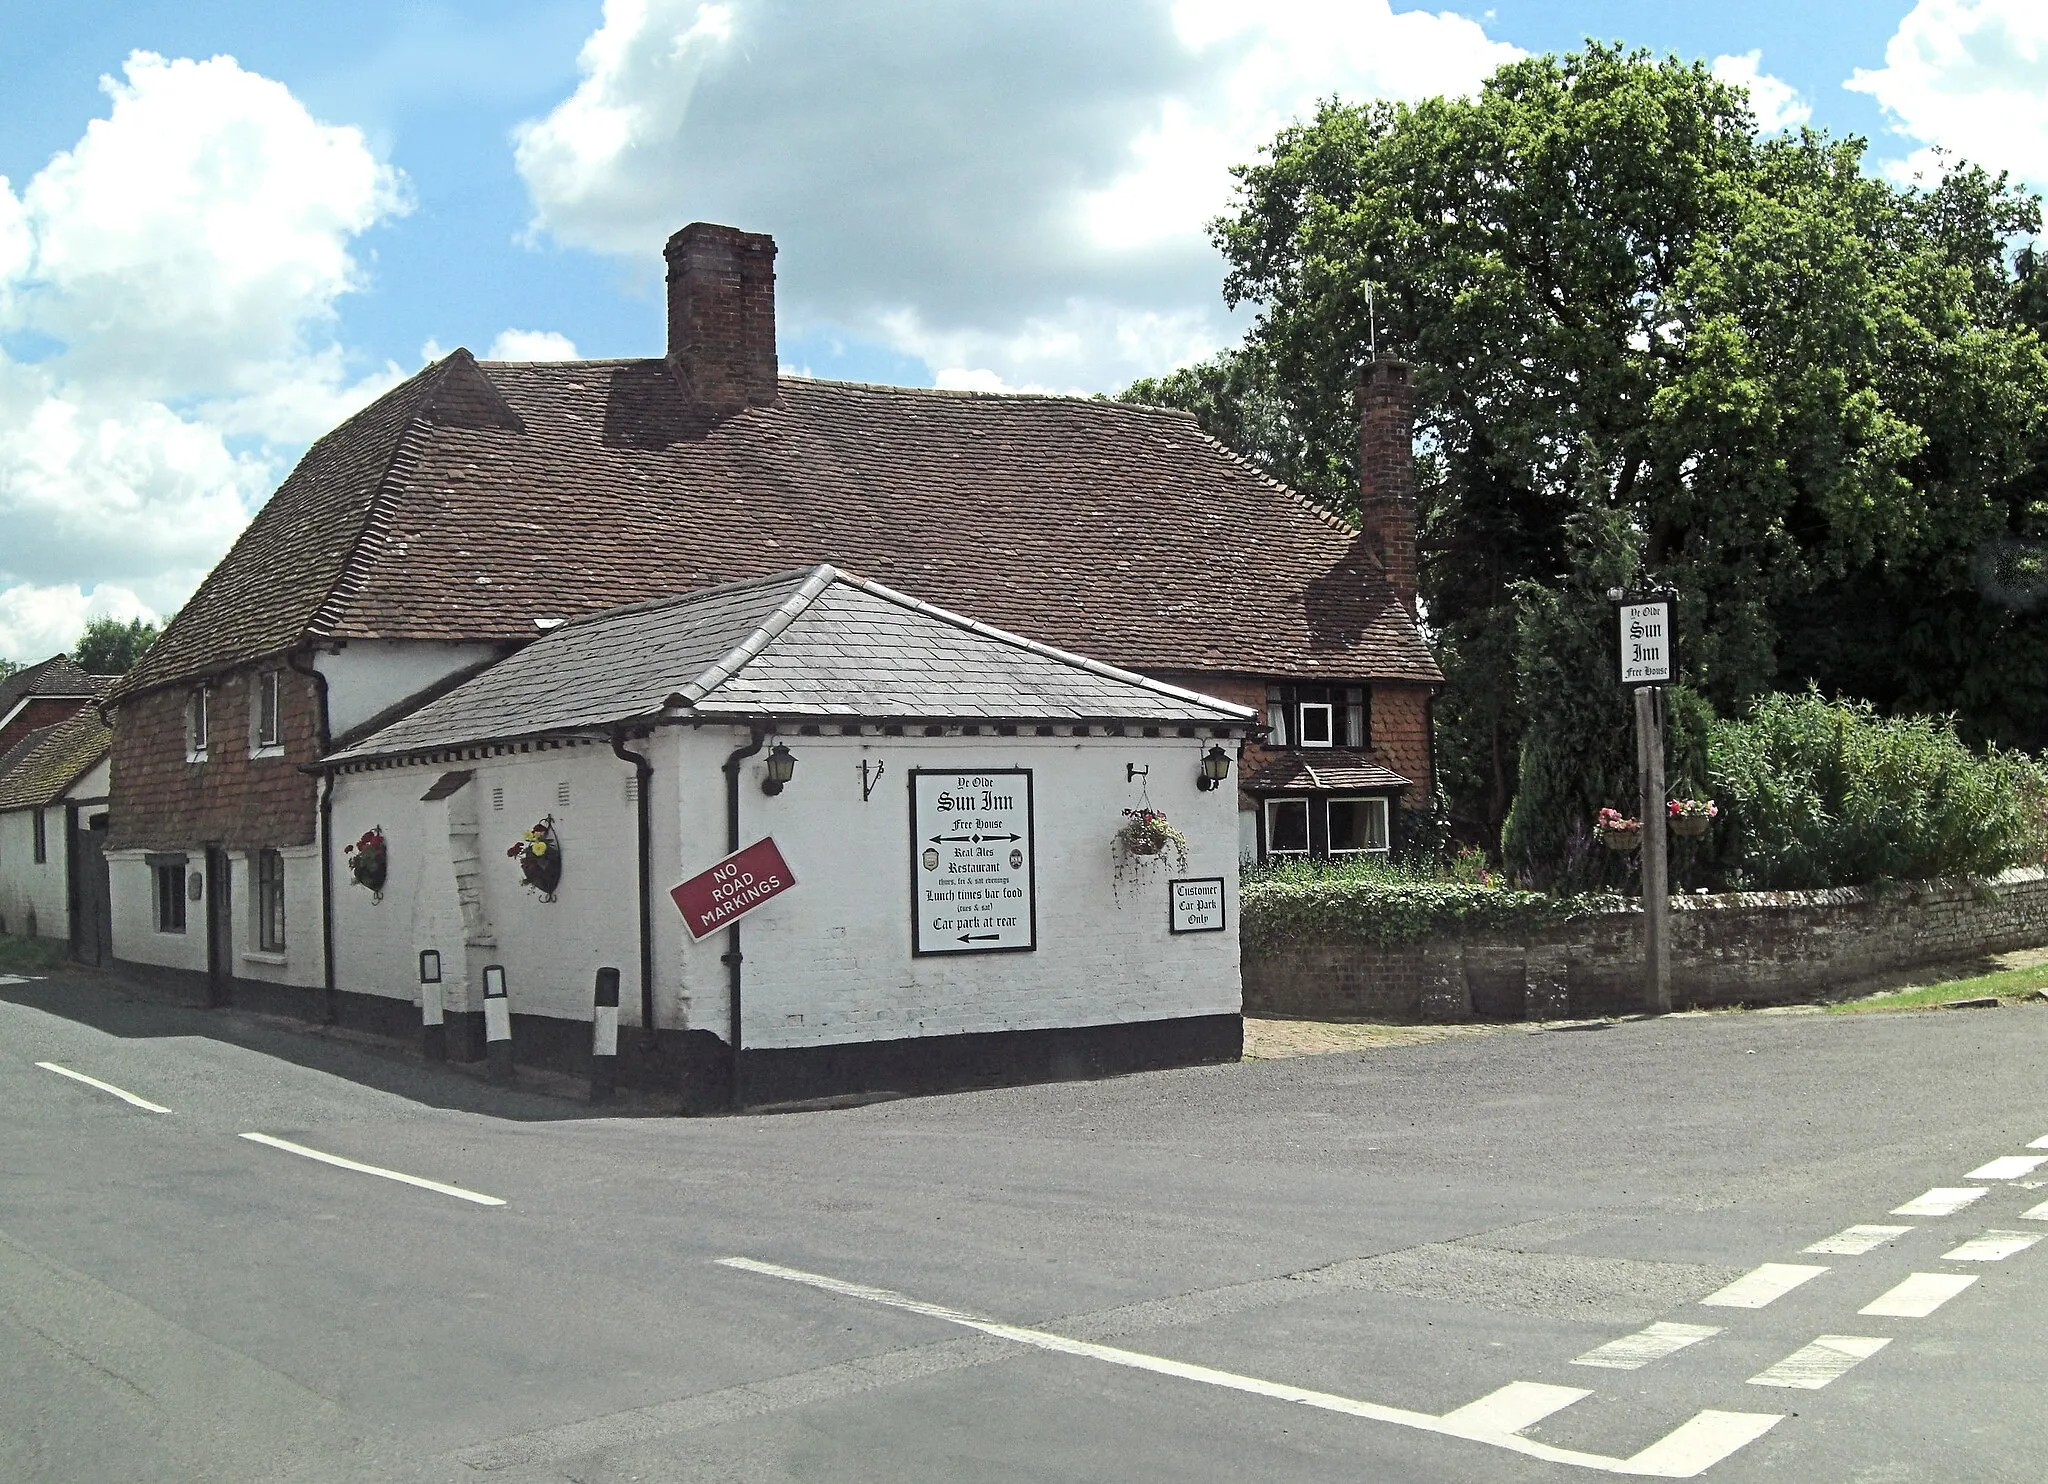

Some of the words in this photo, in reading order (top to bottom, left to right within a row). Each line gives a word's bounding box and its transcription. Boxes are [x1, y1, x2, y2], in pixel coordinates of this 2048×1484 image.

[1630, 608, 1640, 619] Ye
[1642, 607, 1660, 616] Olde
[1630, 621, 1661, 640] Sun
[1632, 644, 1659, 662] Inn
[1625, 667, 1641, 678] Free
[1645, 666, 1667, 675] House
[957, 777, 969, 789] Ye
[972, 777, 993, 787] Olde
[937, 791, 975, 812] Sun
[981, 791, 1013, 811] Inn
[952, 819, 972, 831] Free
[976, 819, 1002, 830] House
[954, 848, 973, 857] Real
[976, 847, 993, 857] Ales
[713, 863, 737, 883] NO
[948, 862, 1000, 873] Restaurant
[712, 872, 754, 901] ROAD
[967, 877, 972, 885] &
[926, 889, 954, 901] Lunch
[985, 888, 999, 899] bar
[1003, 887, 1022, 899] food
[1177, 885, 1217, 896] Customer
[701, 875, 780, 926] MARKINGS
[1179, 900, 1194, 910] Car
[1197, 899, 1217, 911] Park
[981, 903, 993, 911] sat)
[933, 917, 953, 930] Car
[957, 916, 980, 930] park
[983, 917, 993, 927] at
[996, 917, 1017, 927] rear
[1188, 914, 1209, 925] Only
